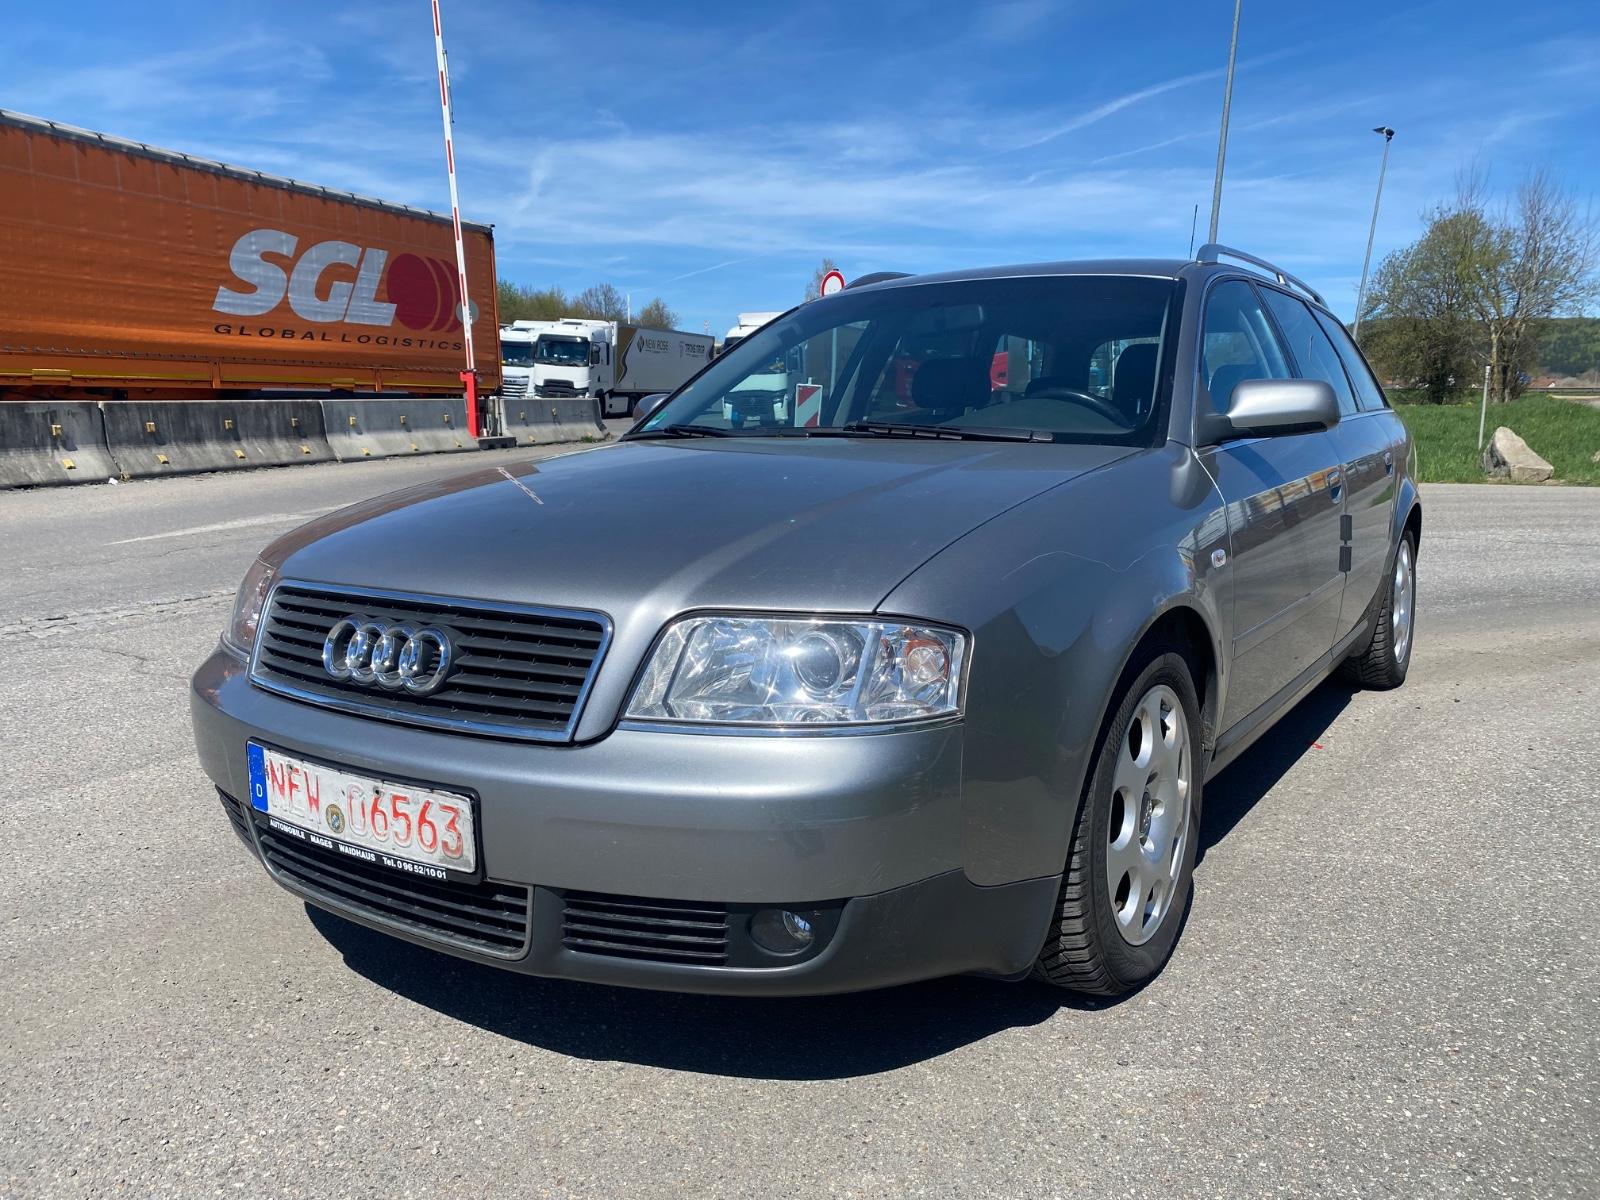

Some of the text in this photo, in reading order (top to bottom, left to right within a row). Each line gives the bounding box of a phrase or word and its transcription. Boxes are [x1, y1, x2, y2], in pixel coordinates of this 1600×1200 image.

[212, 229, 397, 326] SGL
[214, 323, 462, 351] GLOBAL LOGISTICS
[256, 783, 263, 797] D
[270, 819, 306, 840] AUTOMOBILE
[339, 844, 376, 862] WAIDHAUS
[382, 856, 396, 867] Tel.
[348, 784, 464, 859] 06563
